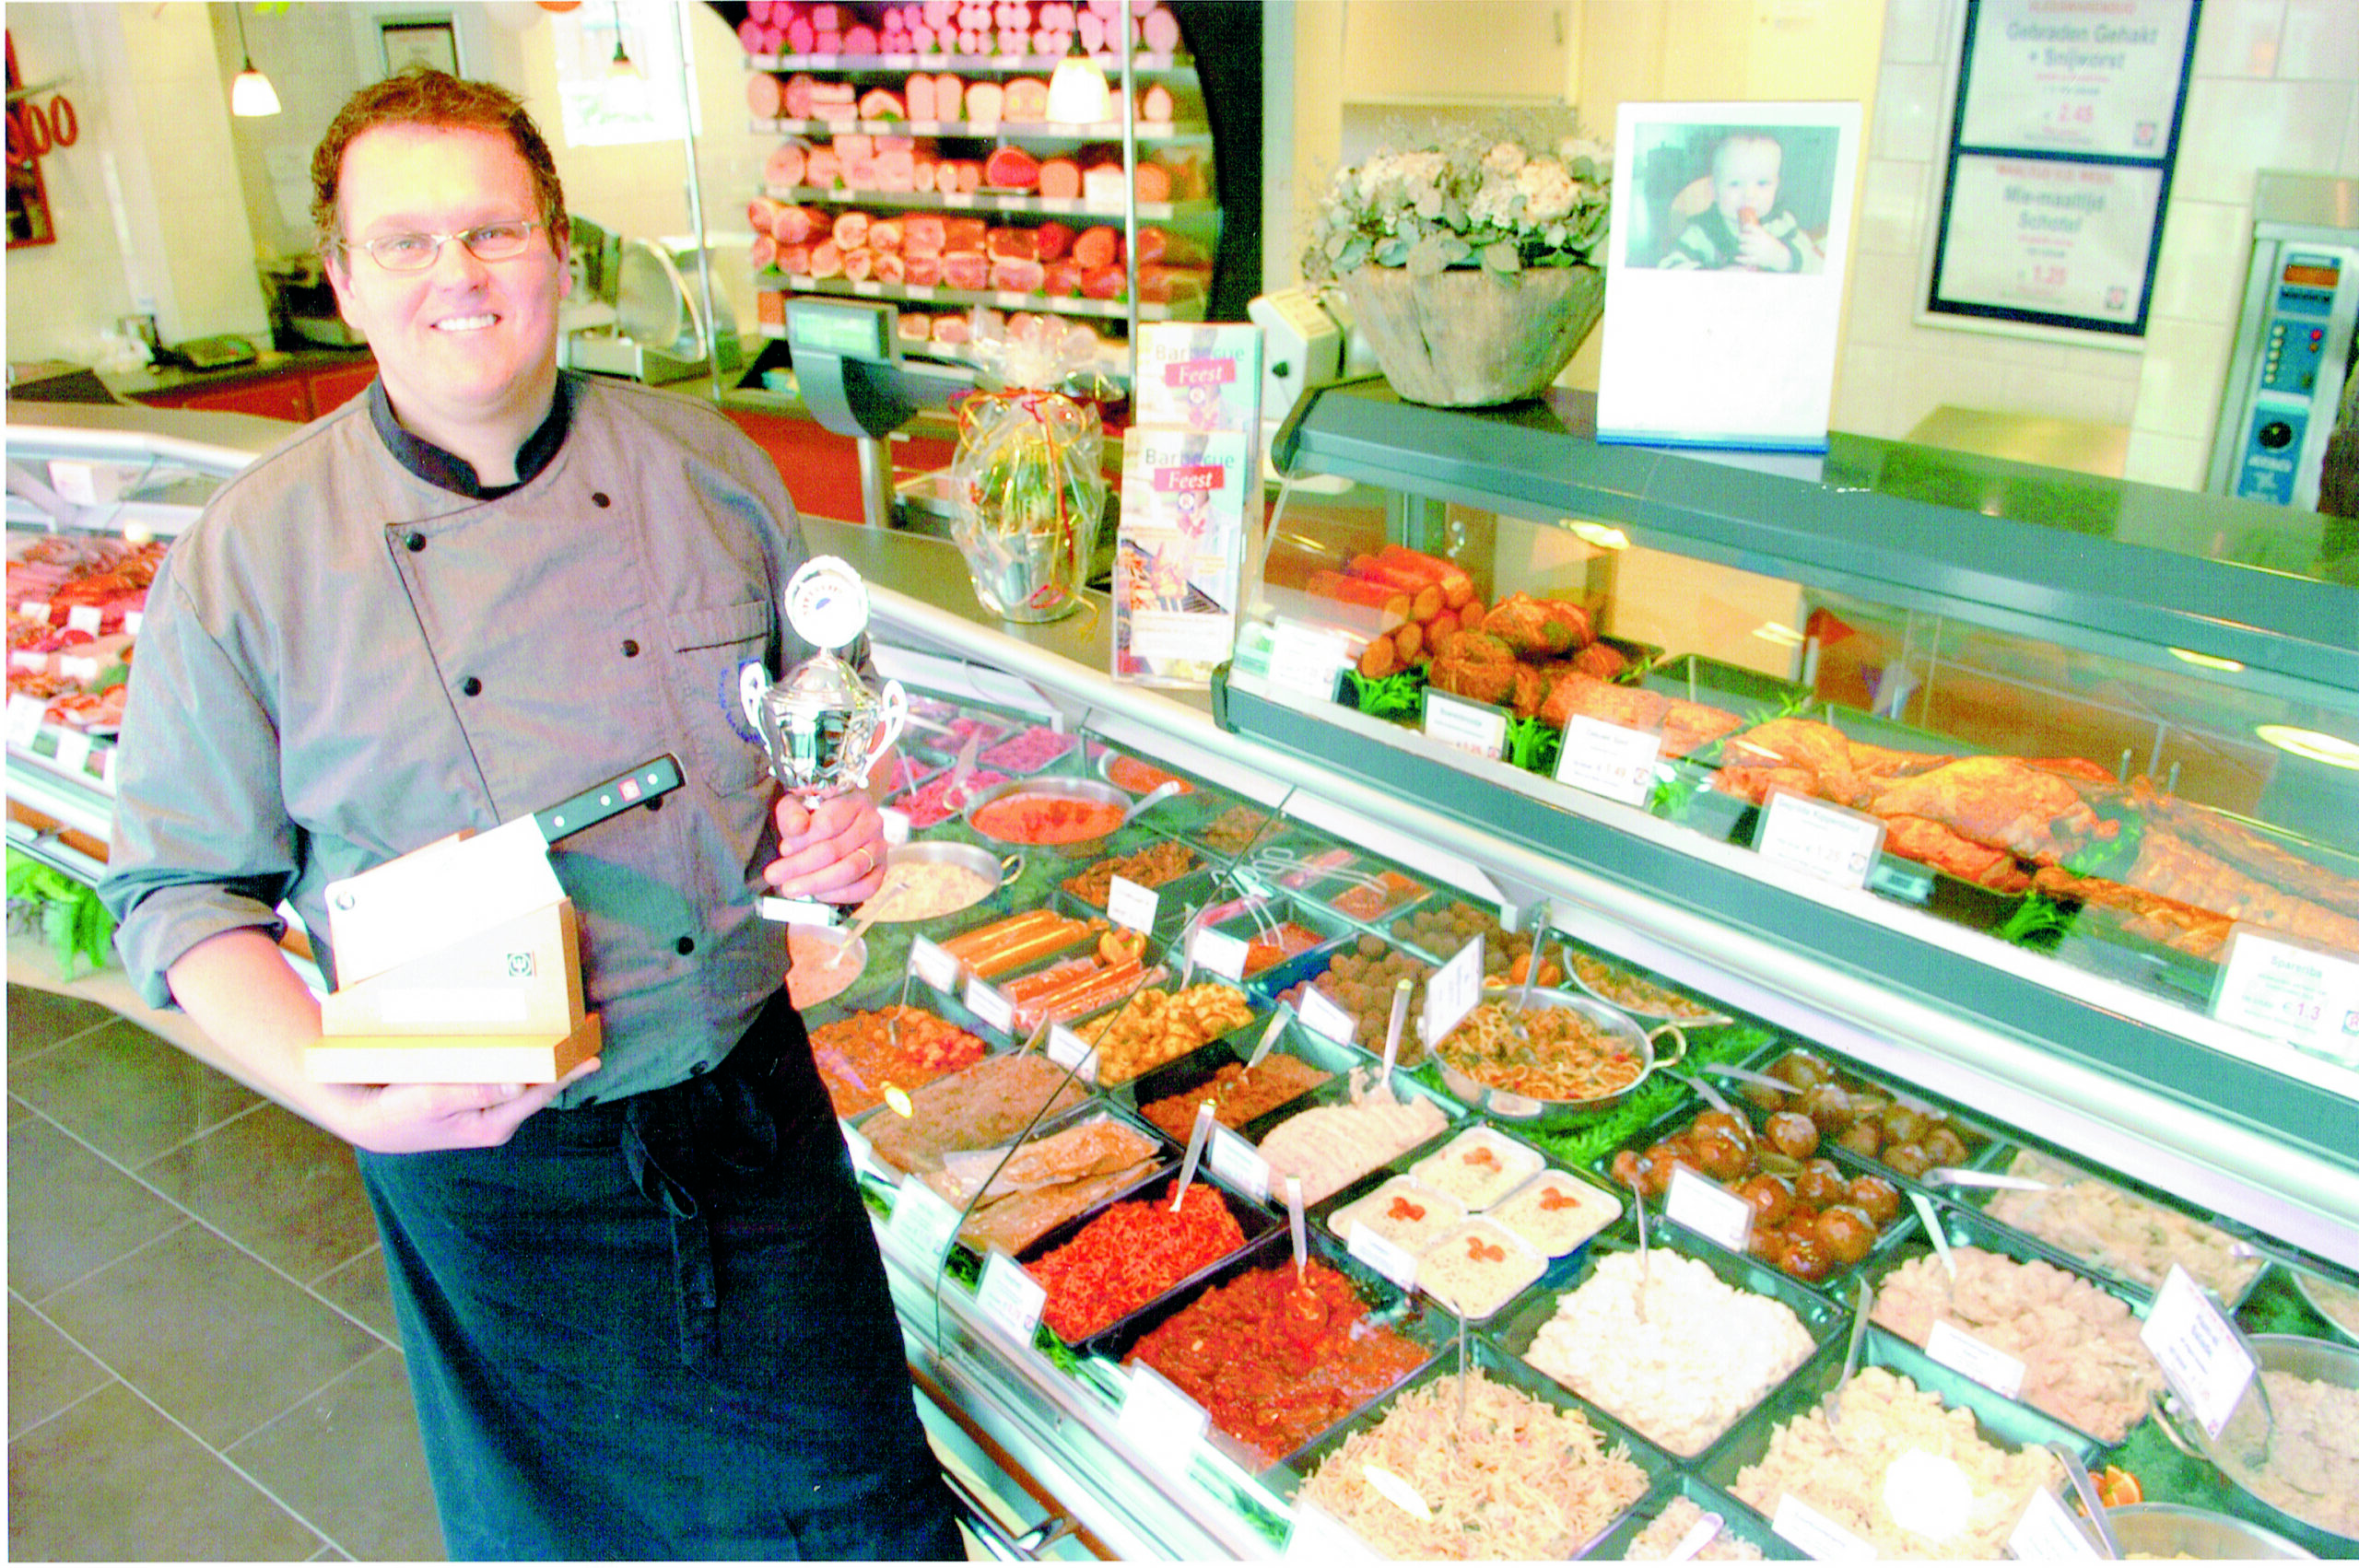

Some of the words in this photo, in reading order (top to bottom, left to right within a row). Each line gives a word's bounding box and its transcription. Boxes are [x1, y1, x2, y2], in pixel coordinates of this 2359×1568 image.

[1156, 344, 1245, 362] Barbecue
[1179, 363, 1222, 384] Feest
[1145, 448, 1235, 468] Barbecue
[1168, 469, 1213, 490] Feest
[2271, 954, 2323, 979] Spareribs
